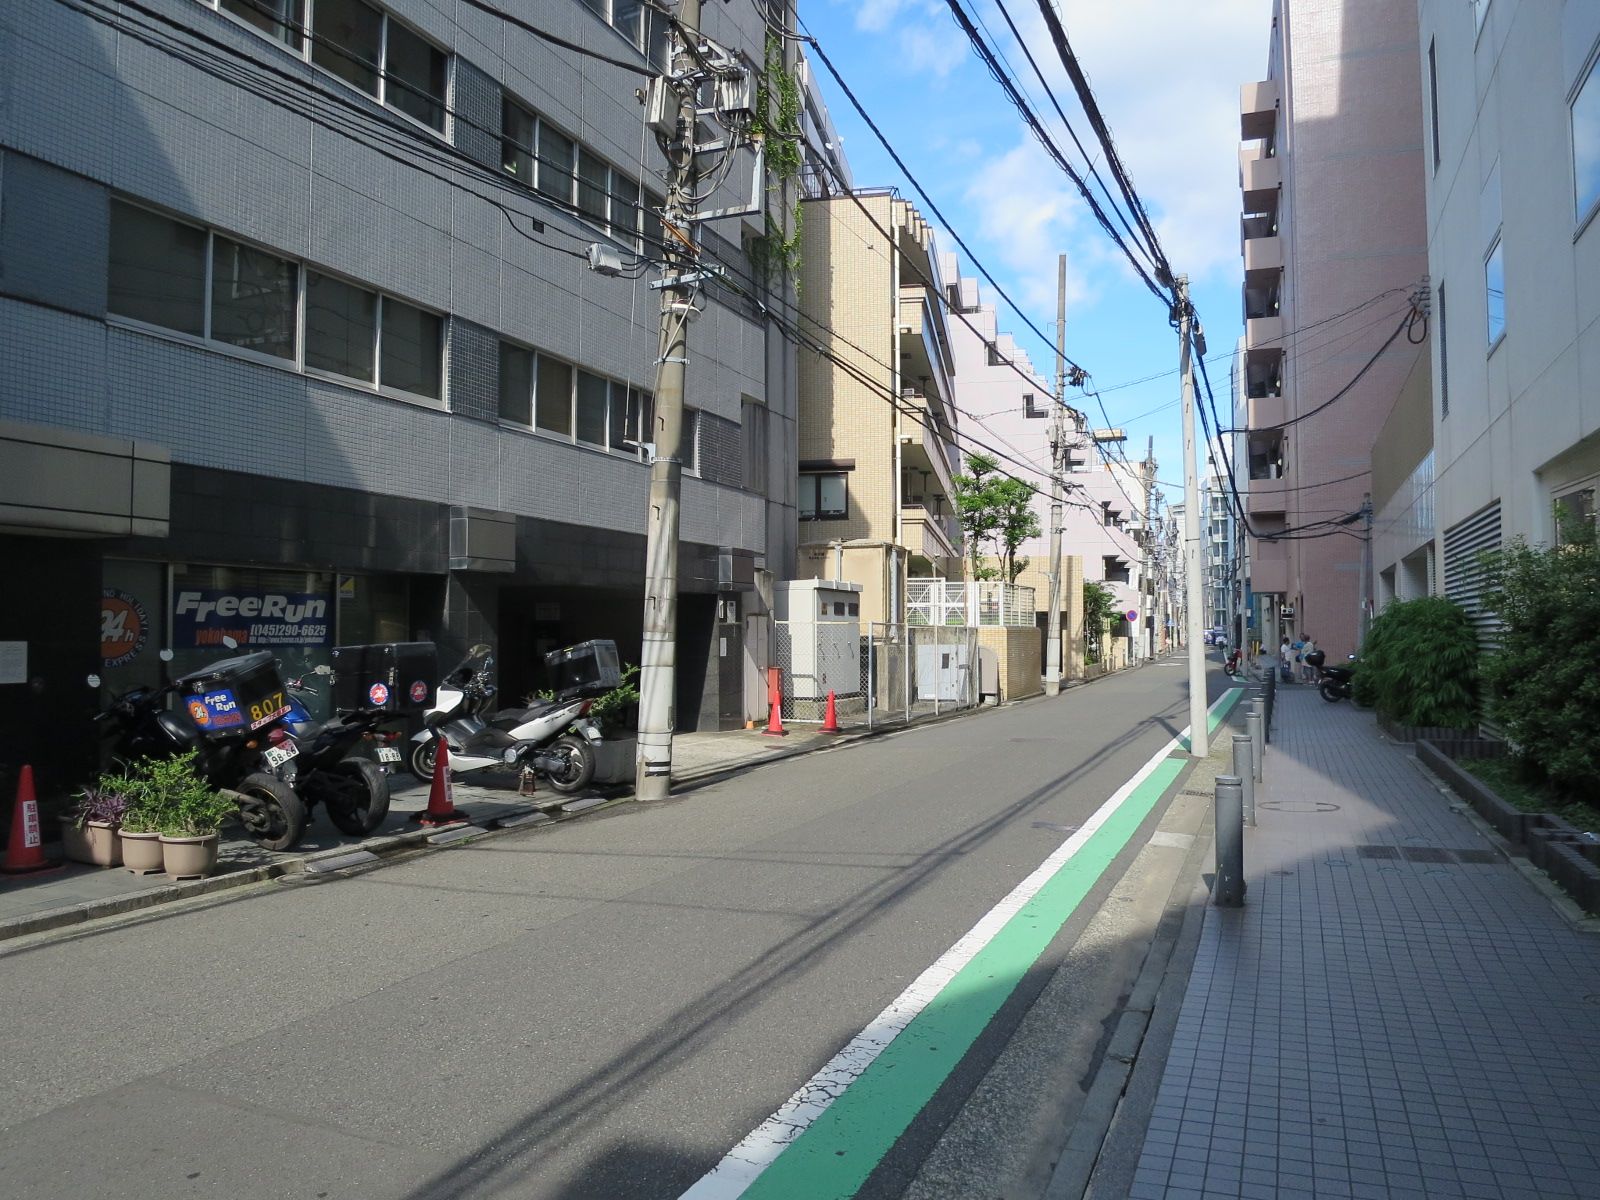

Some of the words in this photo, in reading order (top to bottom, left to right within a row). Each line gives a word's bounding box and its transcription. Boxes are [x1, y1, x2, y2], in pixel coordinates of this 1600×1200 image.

[175, 591, 327, 623] FreeRun
[104, 635, 147, 668] EXPRESS
[204, 694, 227, 705] Free
[215, 701, 236, 712] Run
[250, 692, 283, 721] 807
